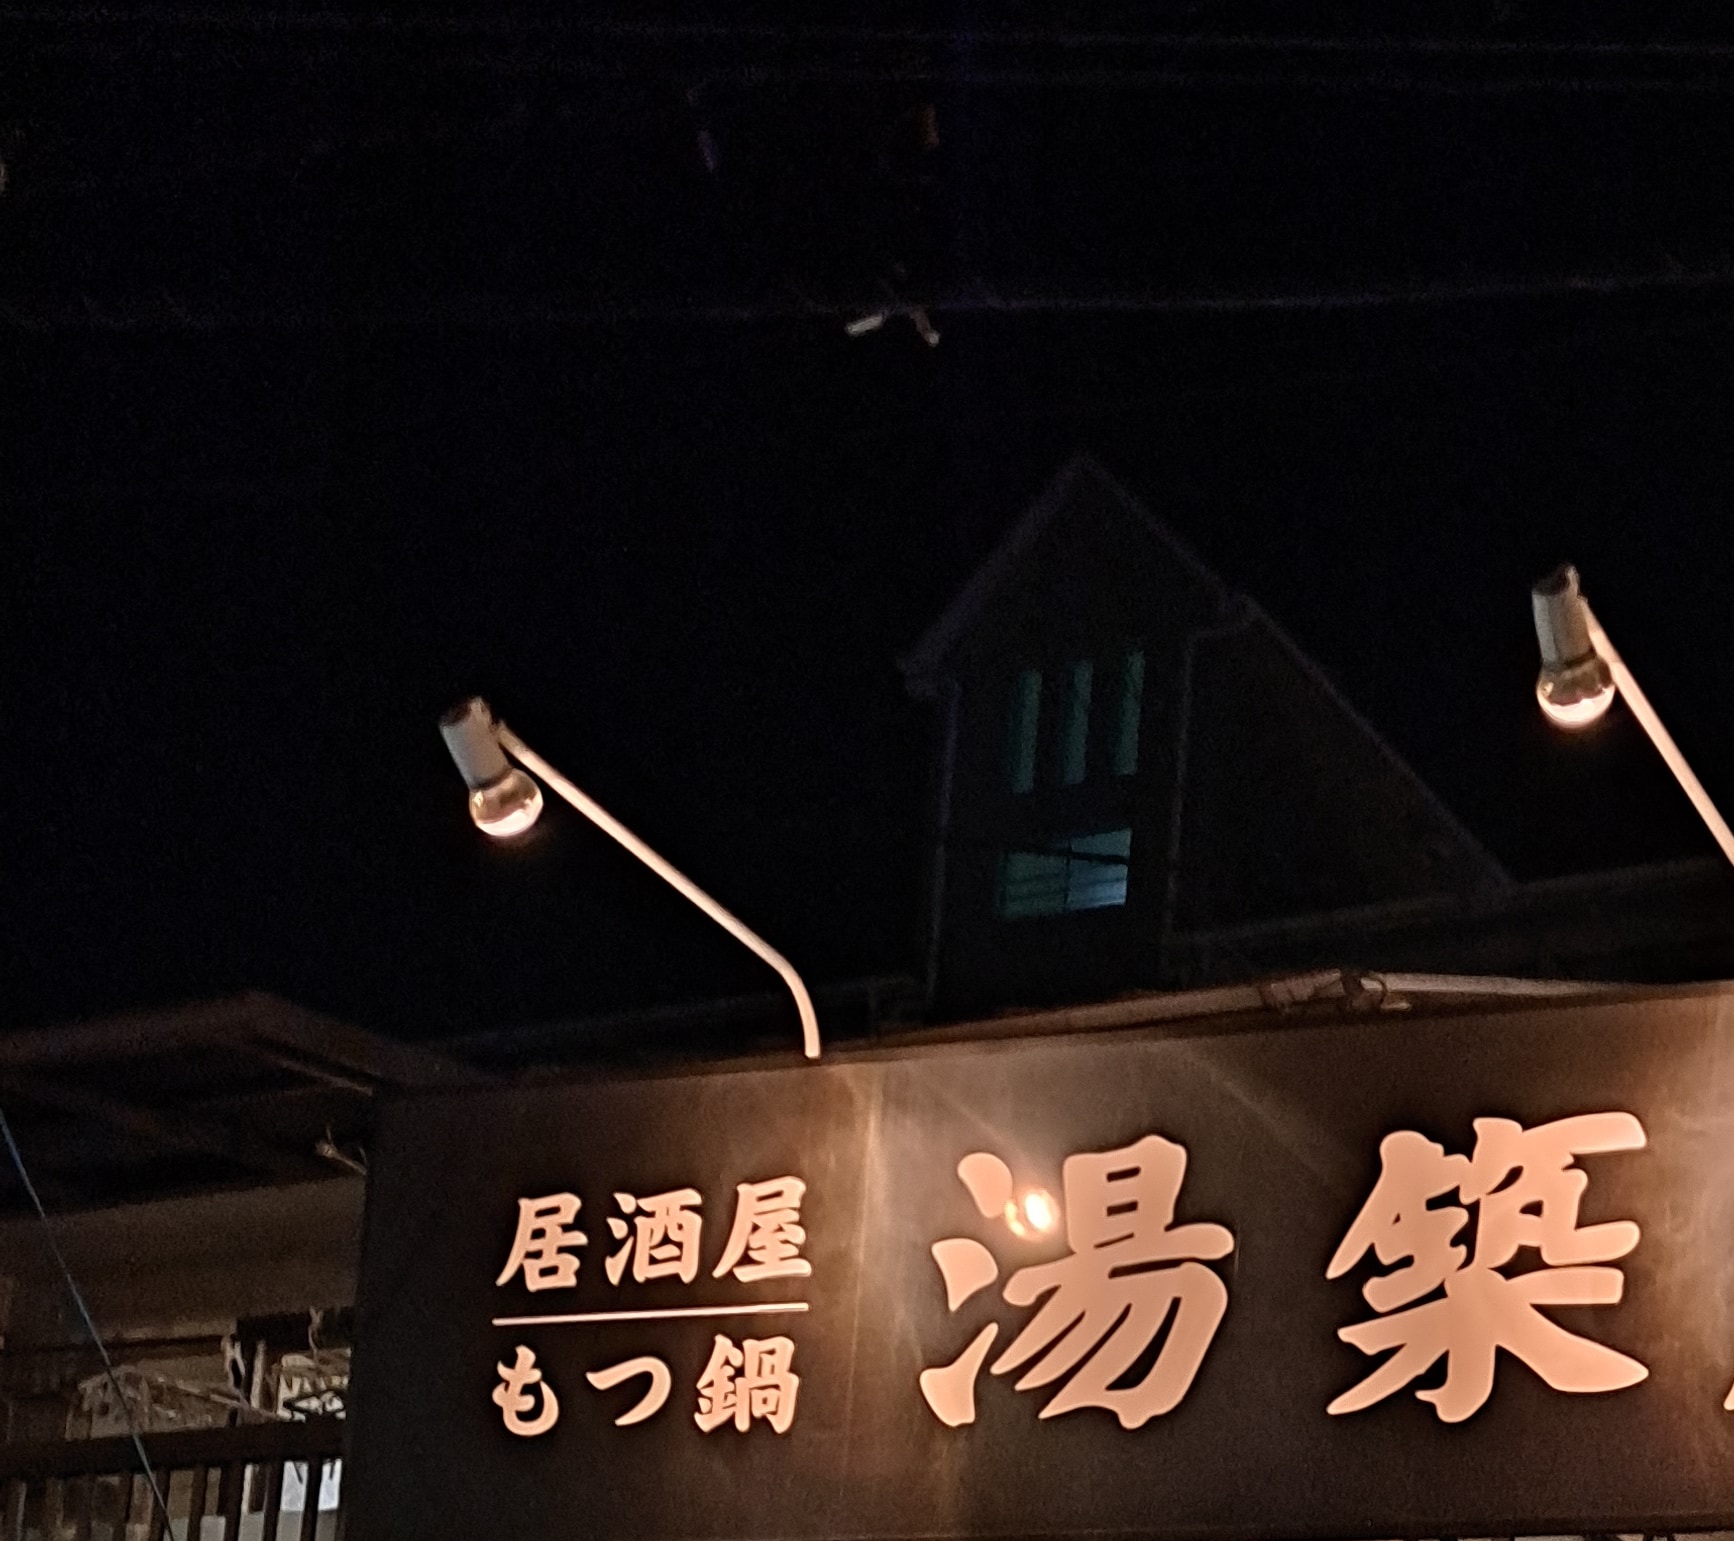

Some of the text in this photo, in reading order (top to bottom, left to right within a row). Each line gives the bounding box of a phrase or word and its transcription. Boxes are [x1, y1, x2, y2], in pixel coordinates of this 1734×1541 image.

[494, 1176, 812, 1292] 居酒屋
[492, 1334, 799, 1436] もつ鍋
